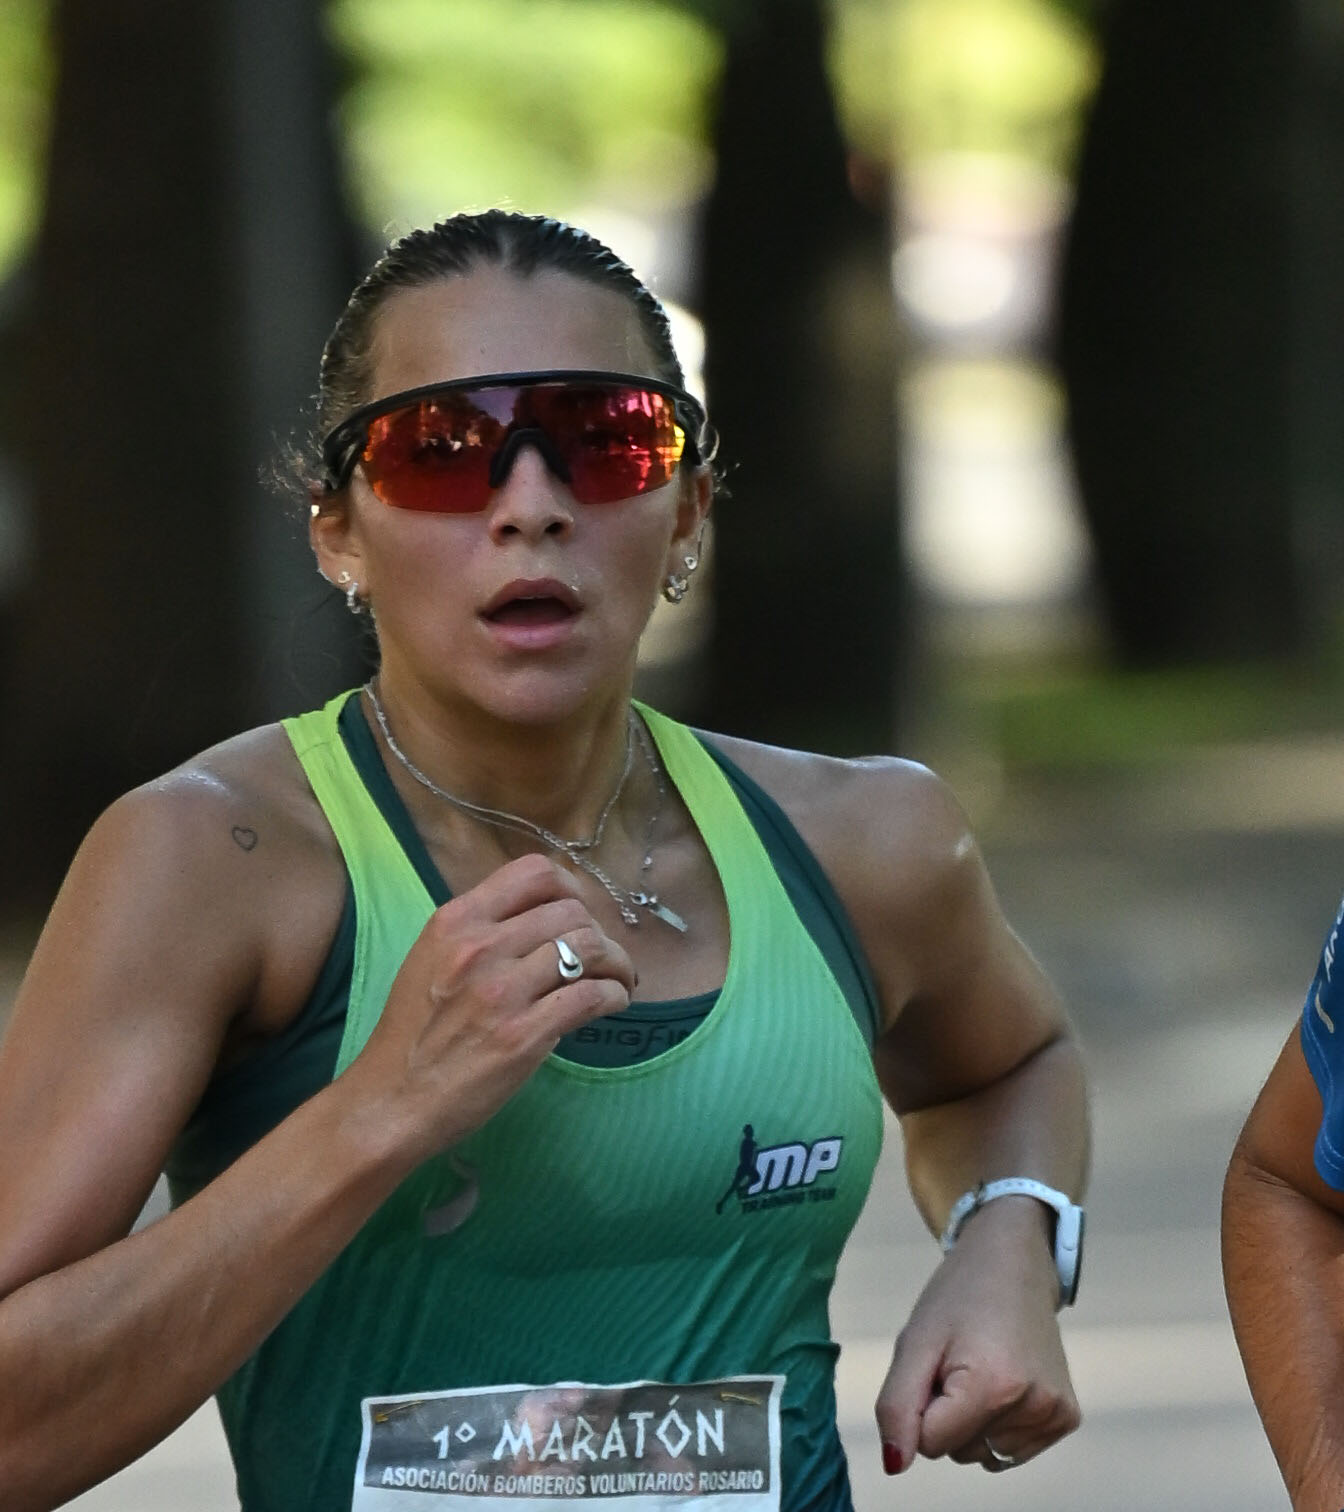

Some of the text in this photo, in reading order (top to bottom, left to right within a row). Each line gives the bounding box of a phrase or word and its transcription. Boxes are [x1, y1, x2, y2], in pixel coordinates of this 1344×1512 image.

[748, 1137, 844, 1195] MP
[492, 1395, 725, 1462] MARATÓN
[381, 1466, 764, 1495] ASOCIACIÓN BOMBEROS VOLUNTARIOS ROSARIO
